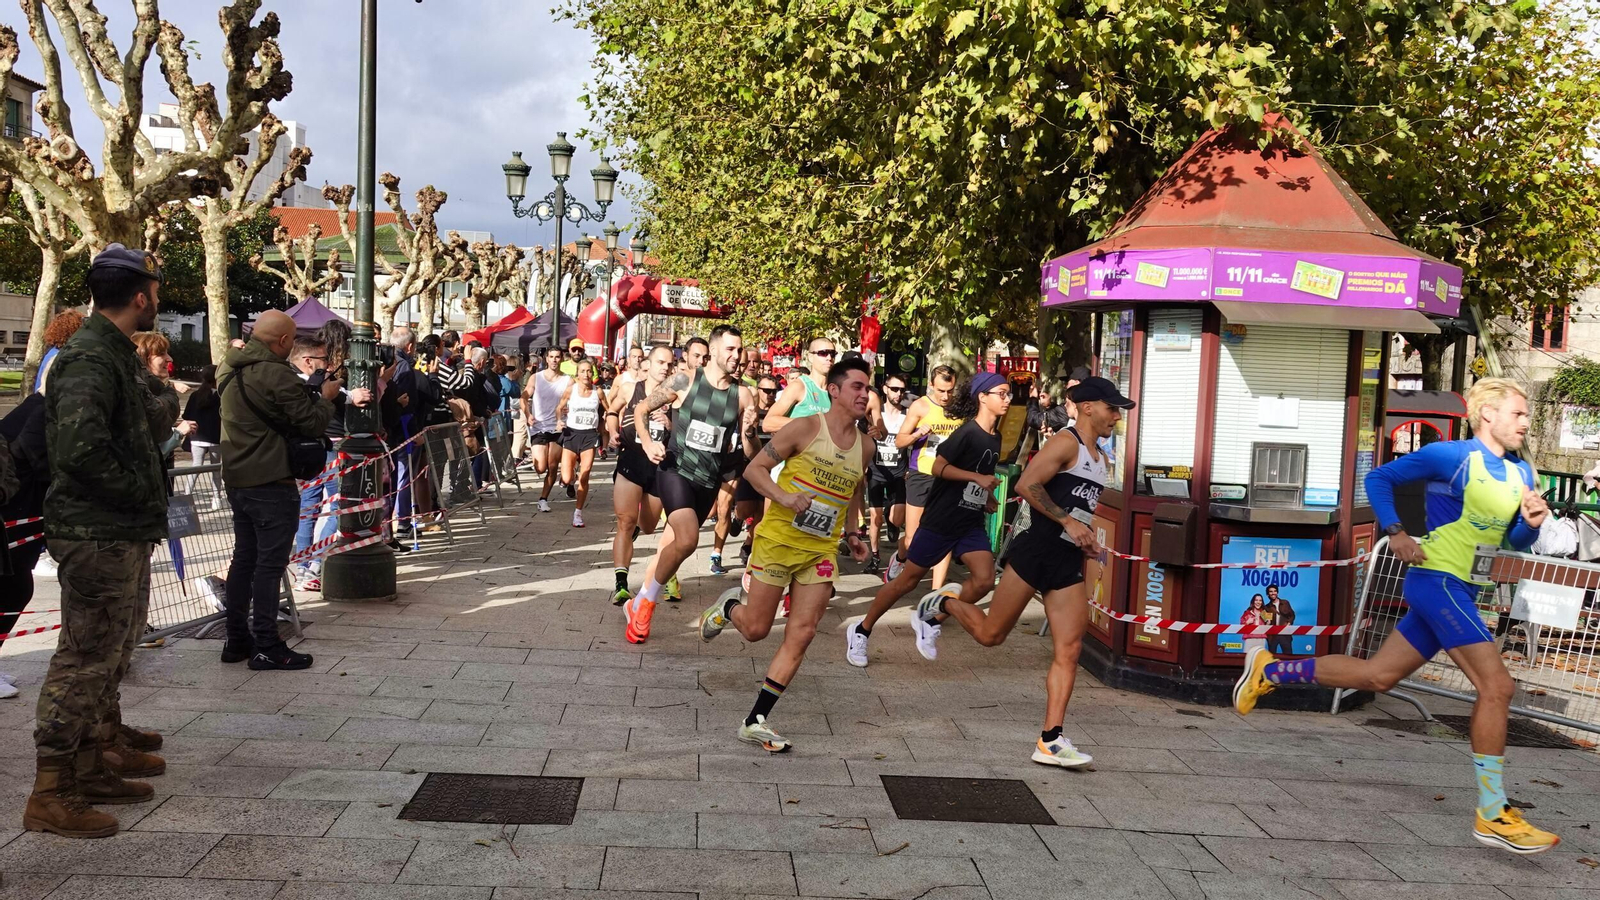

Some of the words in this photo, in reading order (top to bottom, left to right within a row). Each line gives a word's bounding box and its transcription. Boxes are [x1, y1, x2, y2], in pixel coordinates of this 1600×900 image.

[1227, 266, 1263, 284] 11/11
[1347, 278, 1384, 286] PREMIOS
[1390, 271, 1408, 279] MÁIS
[1384, 280, 1406, 294] DÁ
[579, 417, 592, 425] 702
[693, 430, 714, 445] 528
[810, 467, 855, 489] ATHLETICS
[815, 477, 827, 486] San
[1168, 471, 1193, 479] JACKPOT
[803, 511, 828, 528] 772
[1255, 547, 1290, 569] BEN
[1241, 569, 1299, 588] XOGADO
[1144, 604, 1162, 635] BN
